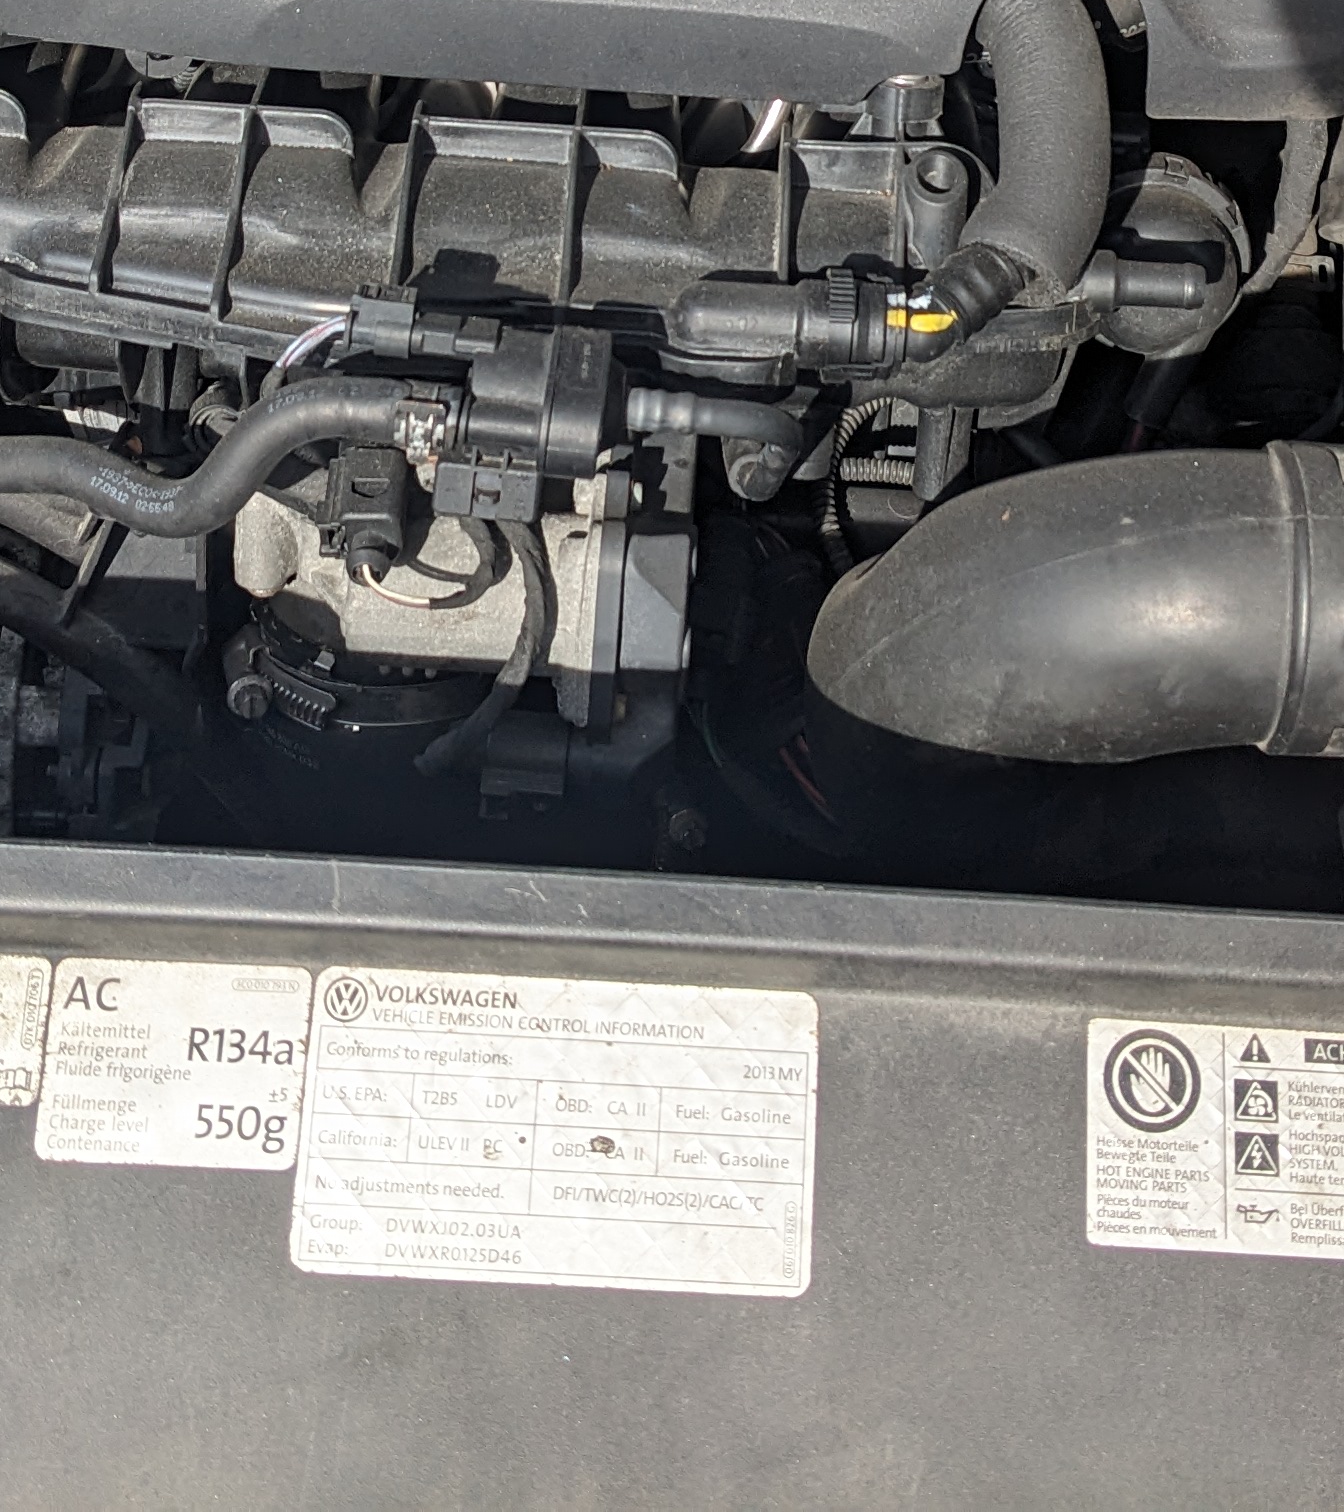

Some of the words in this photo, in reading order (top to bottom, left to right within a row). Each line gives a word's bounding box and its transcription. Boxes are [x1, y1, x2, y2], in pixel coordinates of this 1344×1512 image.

[62, 974, 121, 1012] AC
[374, 983, 518, 1009] VOLKSWAGEN
[59, 1020, 151, 1040] Kältemittel
[371, 1007, 434, 1024] VEHICLE
[438, 1011, 513, 1029] EMISSION
[517, 1015, 591, 1034] CONTROL
[594, 1019, 705, 1040] INFORMATION
[56, 1041, 148, 1062] Refrigerant
[186, 1026, 296, 1066] R134a
[325, 1039, 399, 1059] Conforms
[403, 1046, 420, 1060] to
[423, 1046, 513, 1069] regulations:
[54, 1060, 102, 1077] Fluide
[105, 1061, 192, 1085] frigorigène
[742, 1064, 776, 1081] 2013
[778, 1066, 802, 1082] MY
[50, 1093, 137, 1116] Füllmenge
[421, 1089, 458, 1105] T2B5
[485, 1093, 518, 1109] LDV
[554, 1097, 593, 1113] OBD:
[47, 1113, 106, 1135] Charge
[111, 1115, 149, 1132] level
[675, 1103, 710, 1120] Fuel:
[720, 1106, 791, 1125] Gasoline
[1288, 1108, 1300, 1121] Le
[192, 1102, 289, 1154] 550g
[45, 1133, 140, 1152] Contenance
[317, 1128, 398, 1148] California:
[417, 1134, 457, 1151] ULEV
[1137, 1137, 1198, 1152] Motorteile
[1289, 1142, 1322, 1156] HIGH
[672, 1148, 707, 1165] Fuel:
[718, 1150, 790, 1169] Gasoline
[1095, 1148, 1147, 1165] Bewegte
[1150, 1151, 1176, 1164] Teile
[1289, 1157, 1339, 1171] SYSTEM.
[1096, 1163, 1121, 1176] HOT
[1125, 1165, 1171, 1179] ENGINE
[1174, 1168, 1210, 1182] PARTS
[1289, 1171, 1325, 1185] Haute
[339, 1175, 440, 1199] adjustments
[442, 1180, 505, 1199] needed.
[1095, 1176, 1147, 1191] MOVING
[1151, 1180, 1187, 1193] PARTS
[1096, 1205, 1142, 1220] chaudes
[1131, 1195, 1146, 1207] du
[1148, 1198, 1189, 1210] moteur
[308, 1213, 363, 1234] Group:
[1148, 1224, 1217, 1239] mouvement
